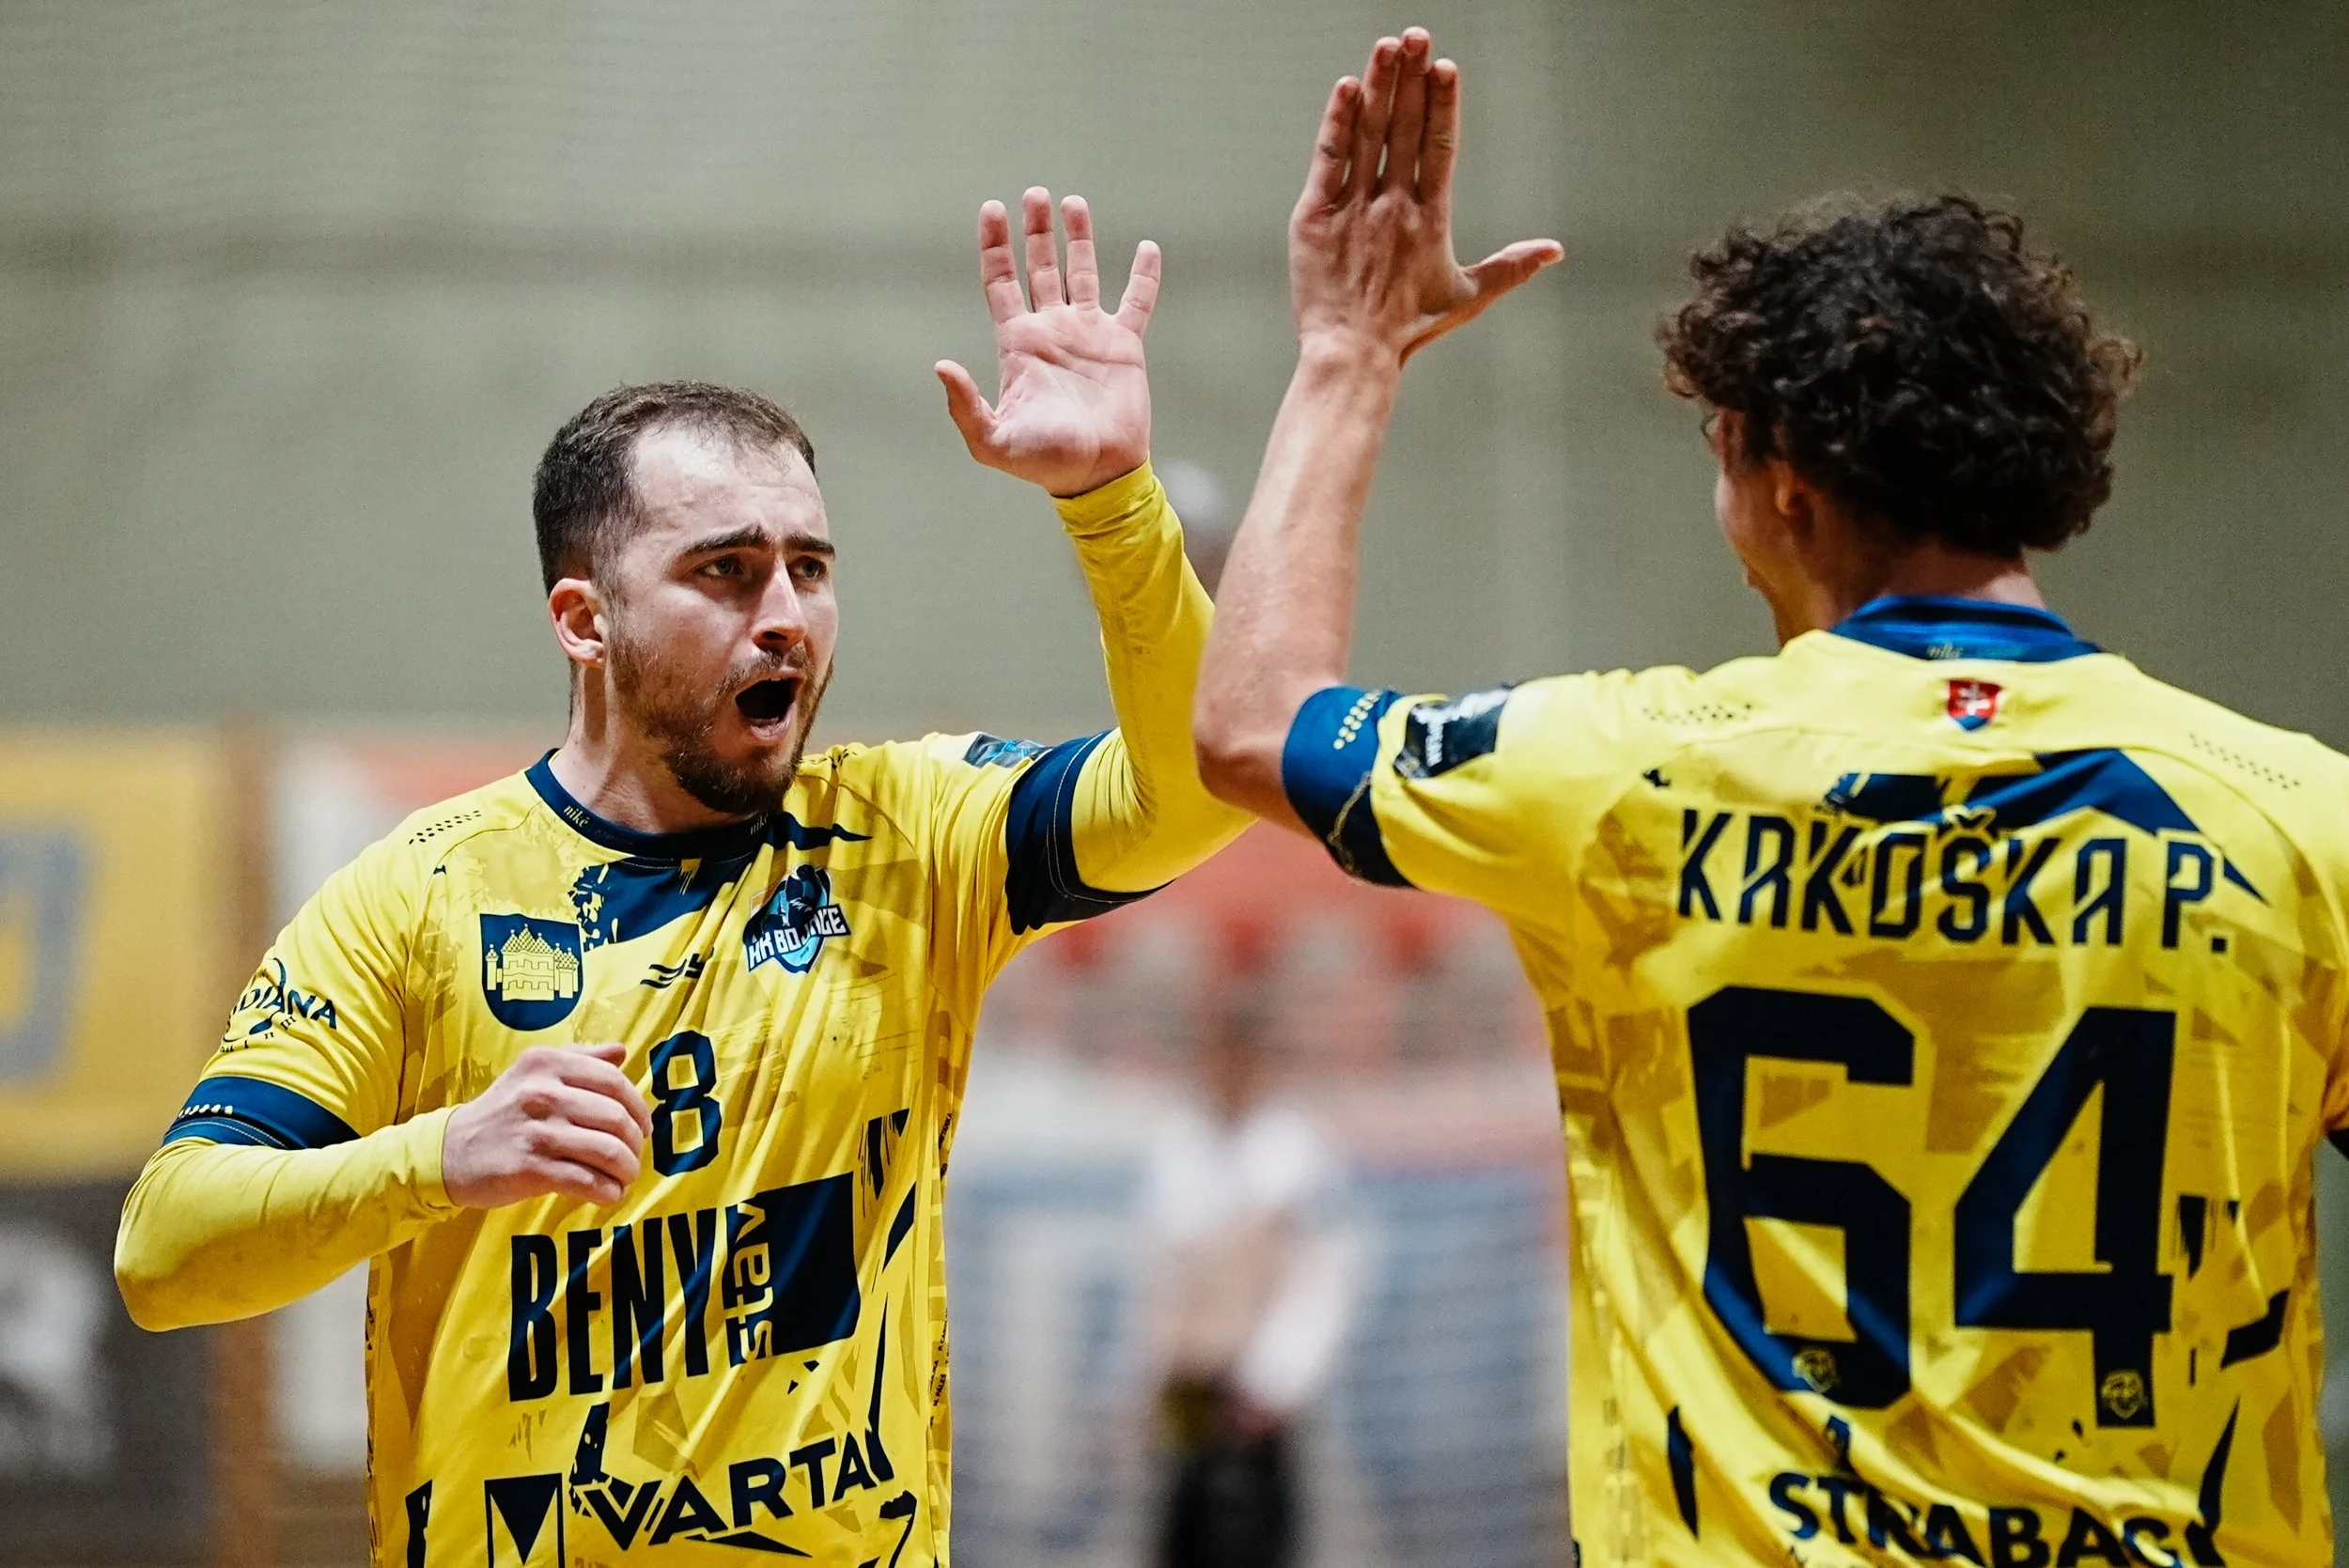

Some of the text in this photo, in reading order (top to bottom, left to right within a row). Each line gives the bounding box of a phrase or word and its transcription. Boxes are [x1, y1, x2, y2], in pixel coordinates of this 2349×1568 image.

[1678, 809, 2229, 954] KRKOŠKA P.
[649, 1030, 723, 1177] 8
[1688, 985, 2177, 1429] 64
[507, 1206, 718, 1403] BENY
[724, 1201, 774, 1363] stav
[583, 1432, 879, 1551] VARTA
[1769, 1471, 2185, 1568] STRABAG
